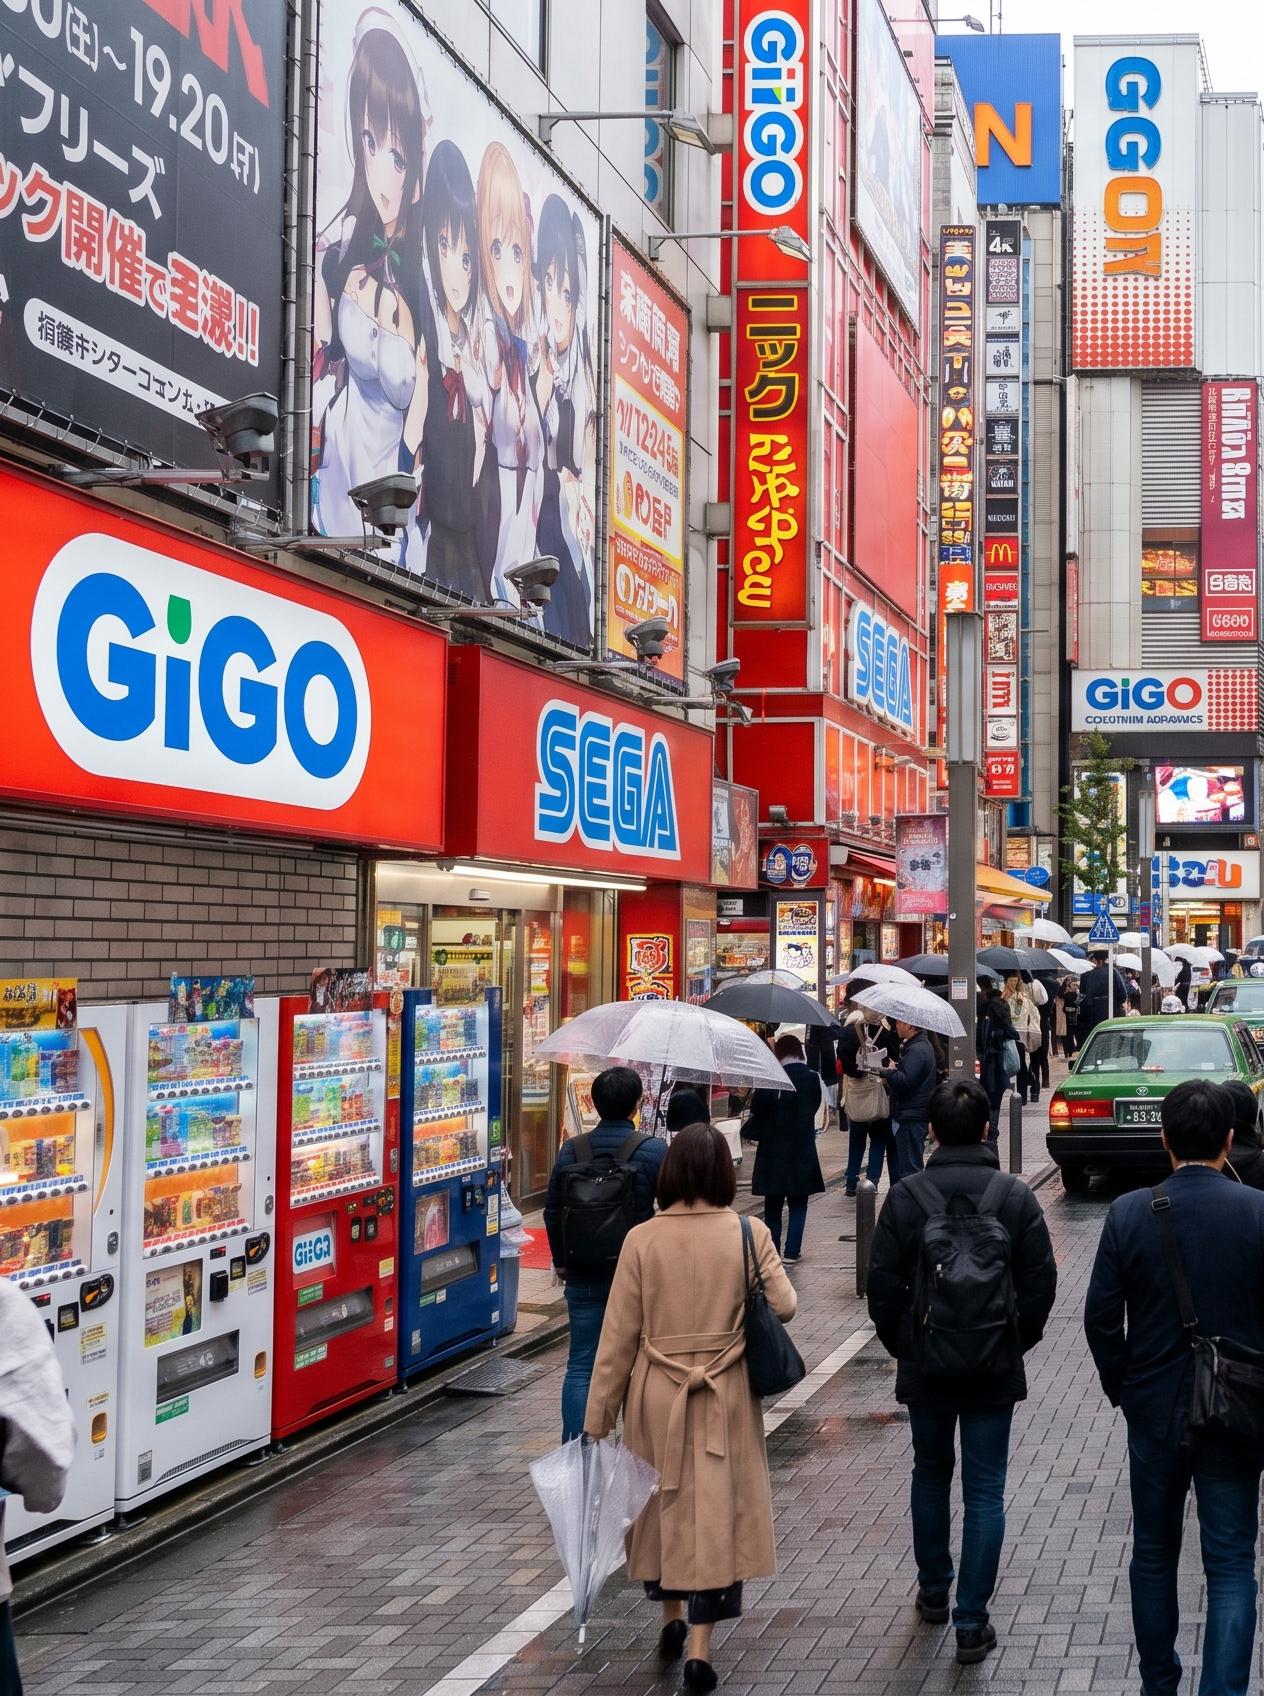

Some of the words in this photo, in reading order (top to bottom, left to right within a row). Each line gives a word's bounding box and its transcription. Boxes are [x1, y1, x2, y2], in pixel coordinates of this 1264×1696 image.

[974, 102, 1033, 167] N
[856, 609, 913, 727] SEGA
[1085, 677, 1203, 711] GiGO
[536, 704, 680, 857] SEGA
